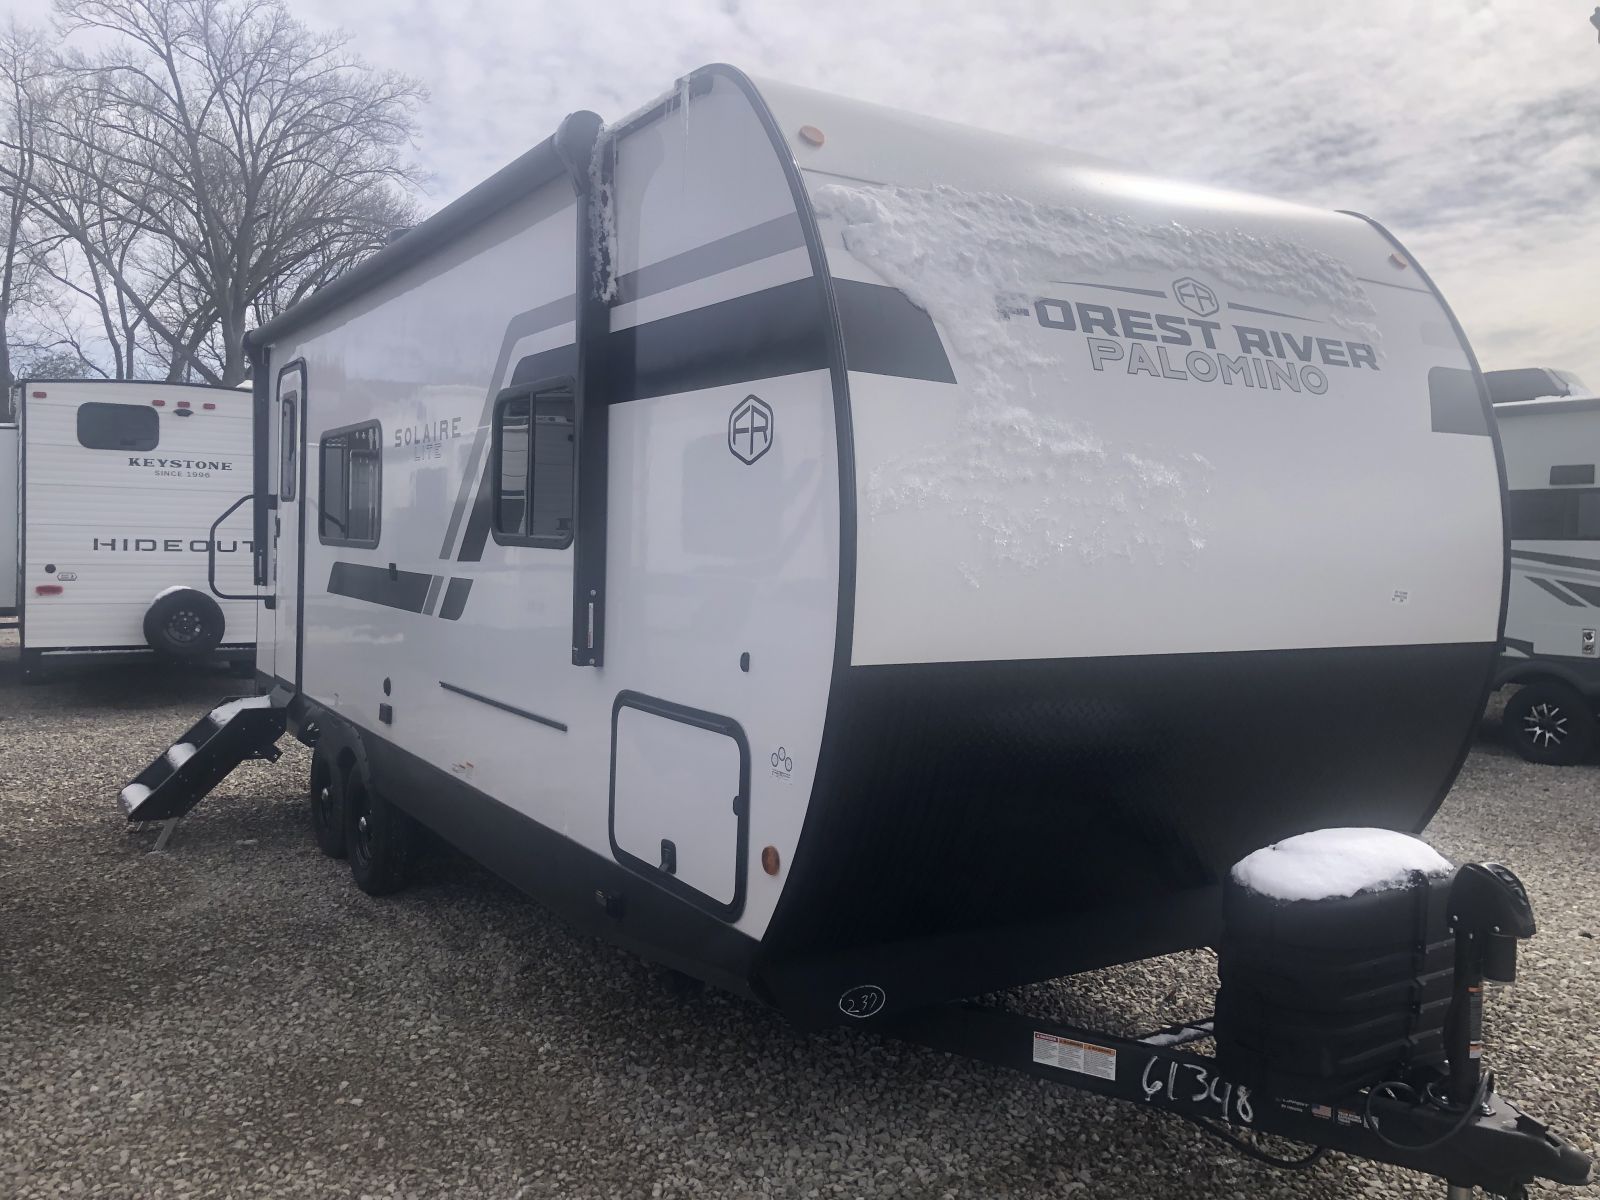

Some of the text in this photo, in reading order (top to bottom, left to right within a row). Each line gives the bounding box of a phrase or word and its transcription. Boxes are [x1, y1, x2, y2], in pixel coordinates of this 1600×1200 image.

[998, 296, 1381, 371] OREST RIVER
[1087, 336, 1329, 395] PALOMINO
[394, 416, 462, 448] SOLAIRE
[127, 457, 233, 471] KEYSTONE
[154, 470, 211, 479] SINCE 1996
[847, 992, 878, 1013] 237
[1142, 1055, 1253, 1123] 61348
